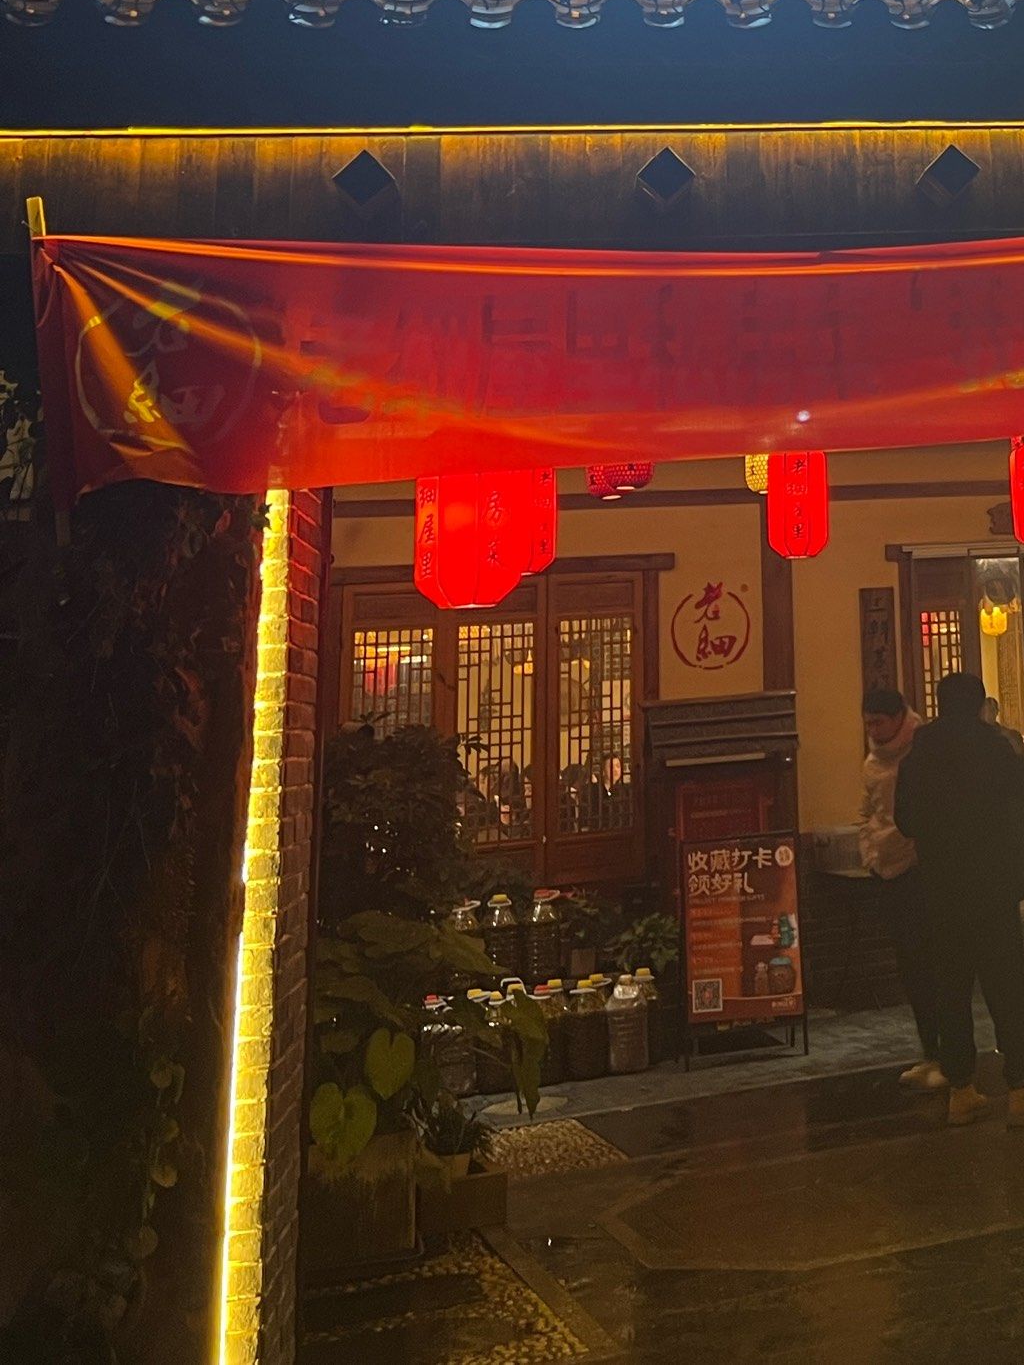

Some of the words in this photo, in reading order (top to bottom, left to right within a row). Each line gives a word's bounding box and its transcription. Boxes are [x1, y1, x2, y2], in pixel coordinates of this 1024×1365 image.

[688, 846, 773, 874] 收藏打卡
[688, 871, 755, 897] 领好礼
